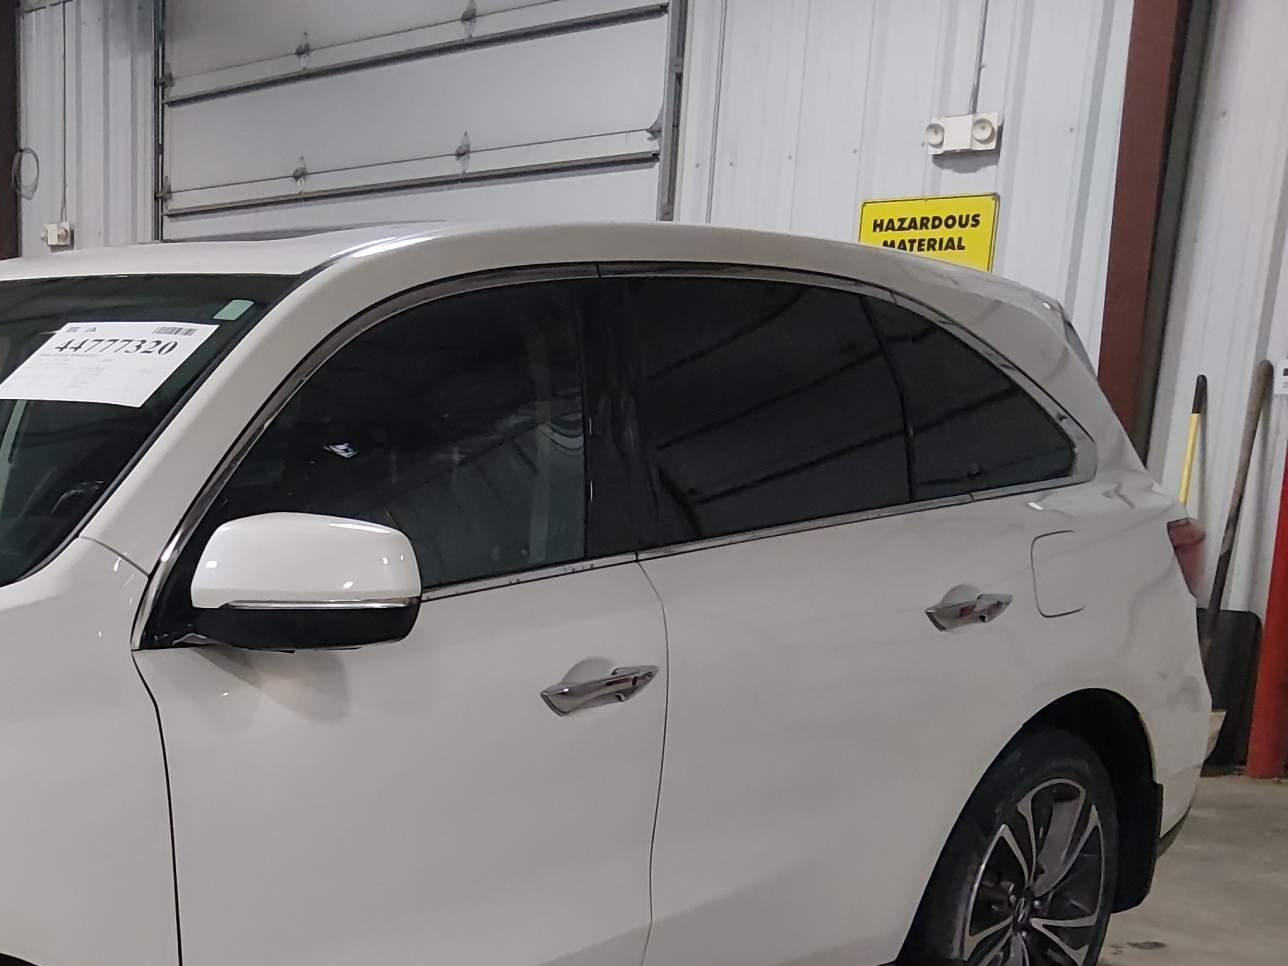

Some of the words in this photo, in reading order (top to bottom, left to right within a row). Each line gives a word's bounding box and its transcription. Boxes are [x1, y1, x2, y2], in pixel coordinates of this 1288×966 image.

[872, 213, 981, 233] HAZARDOUS
[881, 236, 966, 252] MATERIAL
[54, 338, 179, 356] 44777320
